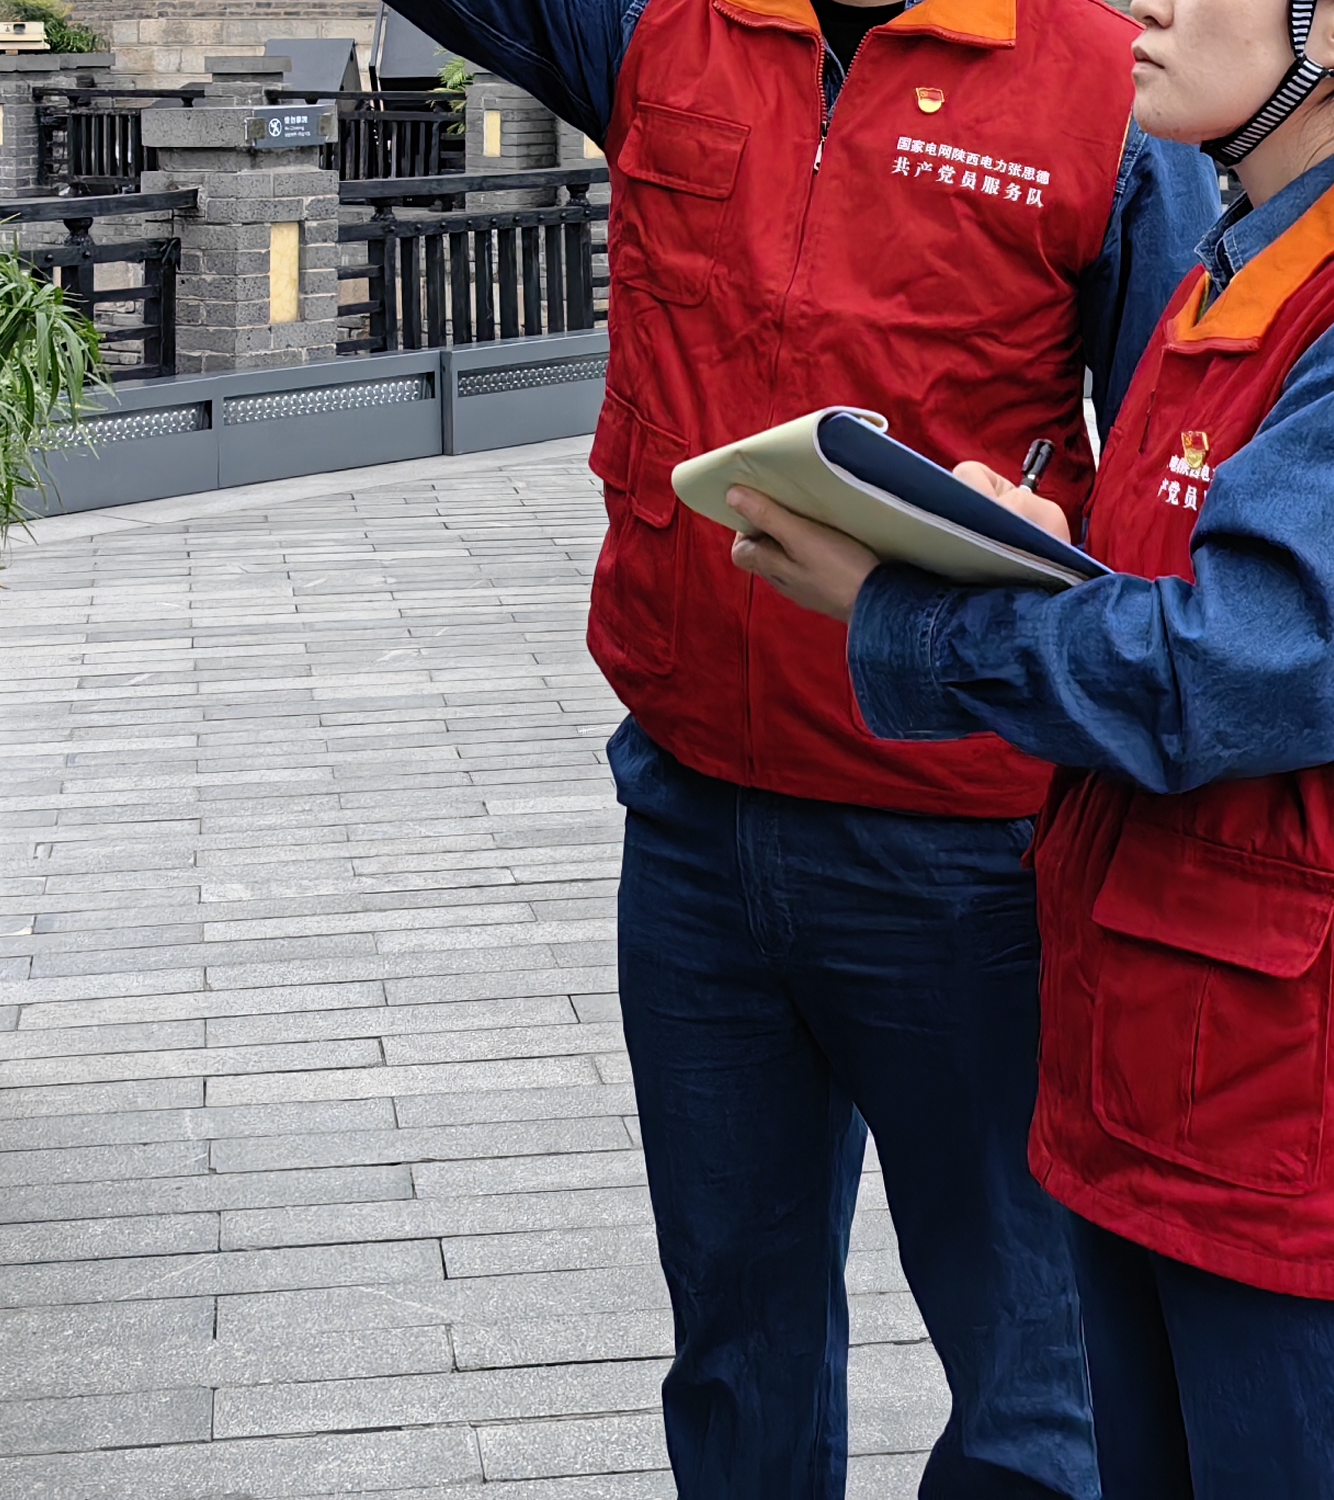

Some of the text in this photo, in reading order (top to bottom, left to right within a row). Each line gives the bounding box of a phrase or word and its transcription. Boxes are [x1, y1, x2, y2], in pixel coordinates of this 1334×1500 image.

[892, 156, 1044, 208] 共产党员服务队
[898, 136, 1050, 185] 国家电网陕西电力张思德
